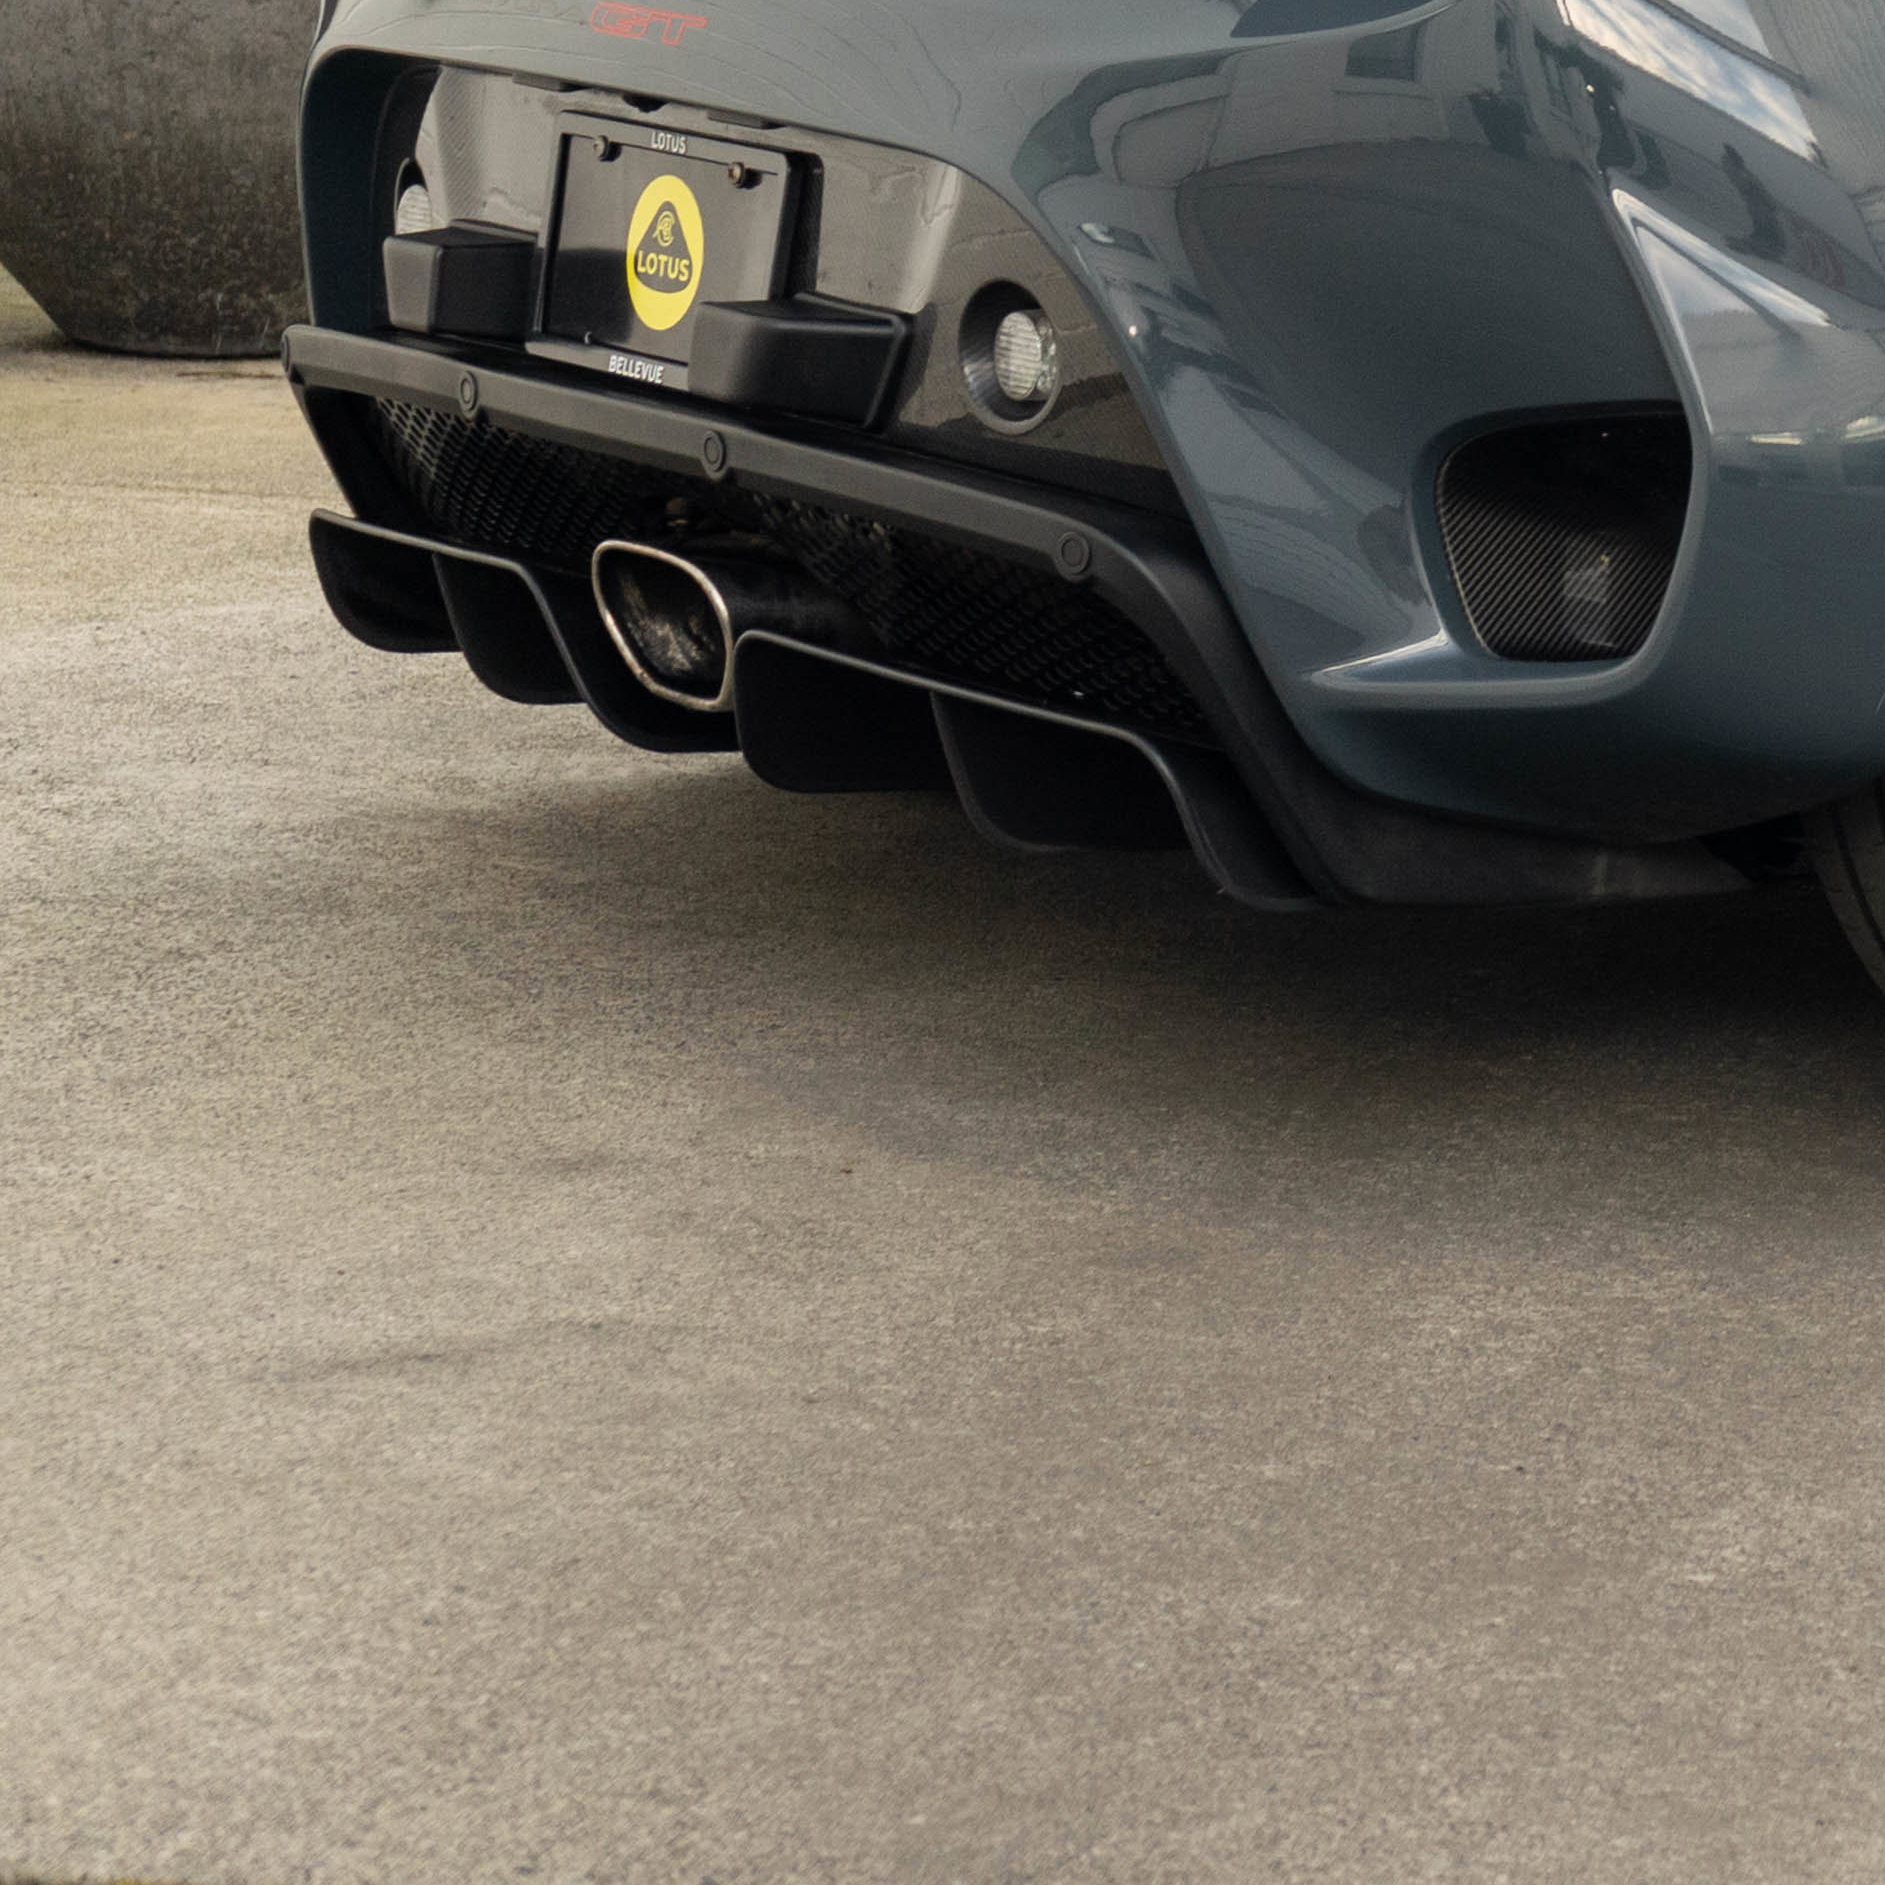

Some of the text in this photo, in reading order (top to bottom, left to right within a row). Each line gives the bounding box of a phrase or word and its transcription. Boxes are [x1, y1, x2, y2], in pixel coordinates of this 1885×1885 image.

[590, 1, 708, 46] GT
[651, 131, 687, 155] LOTUS
[637, 250, 690, 282] LOTUS
[608, 354, 664, 384] BELLEVUE
